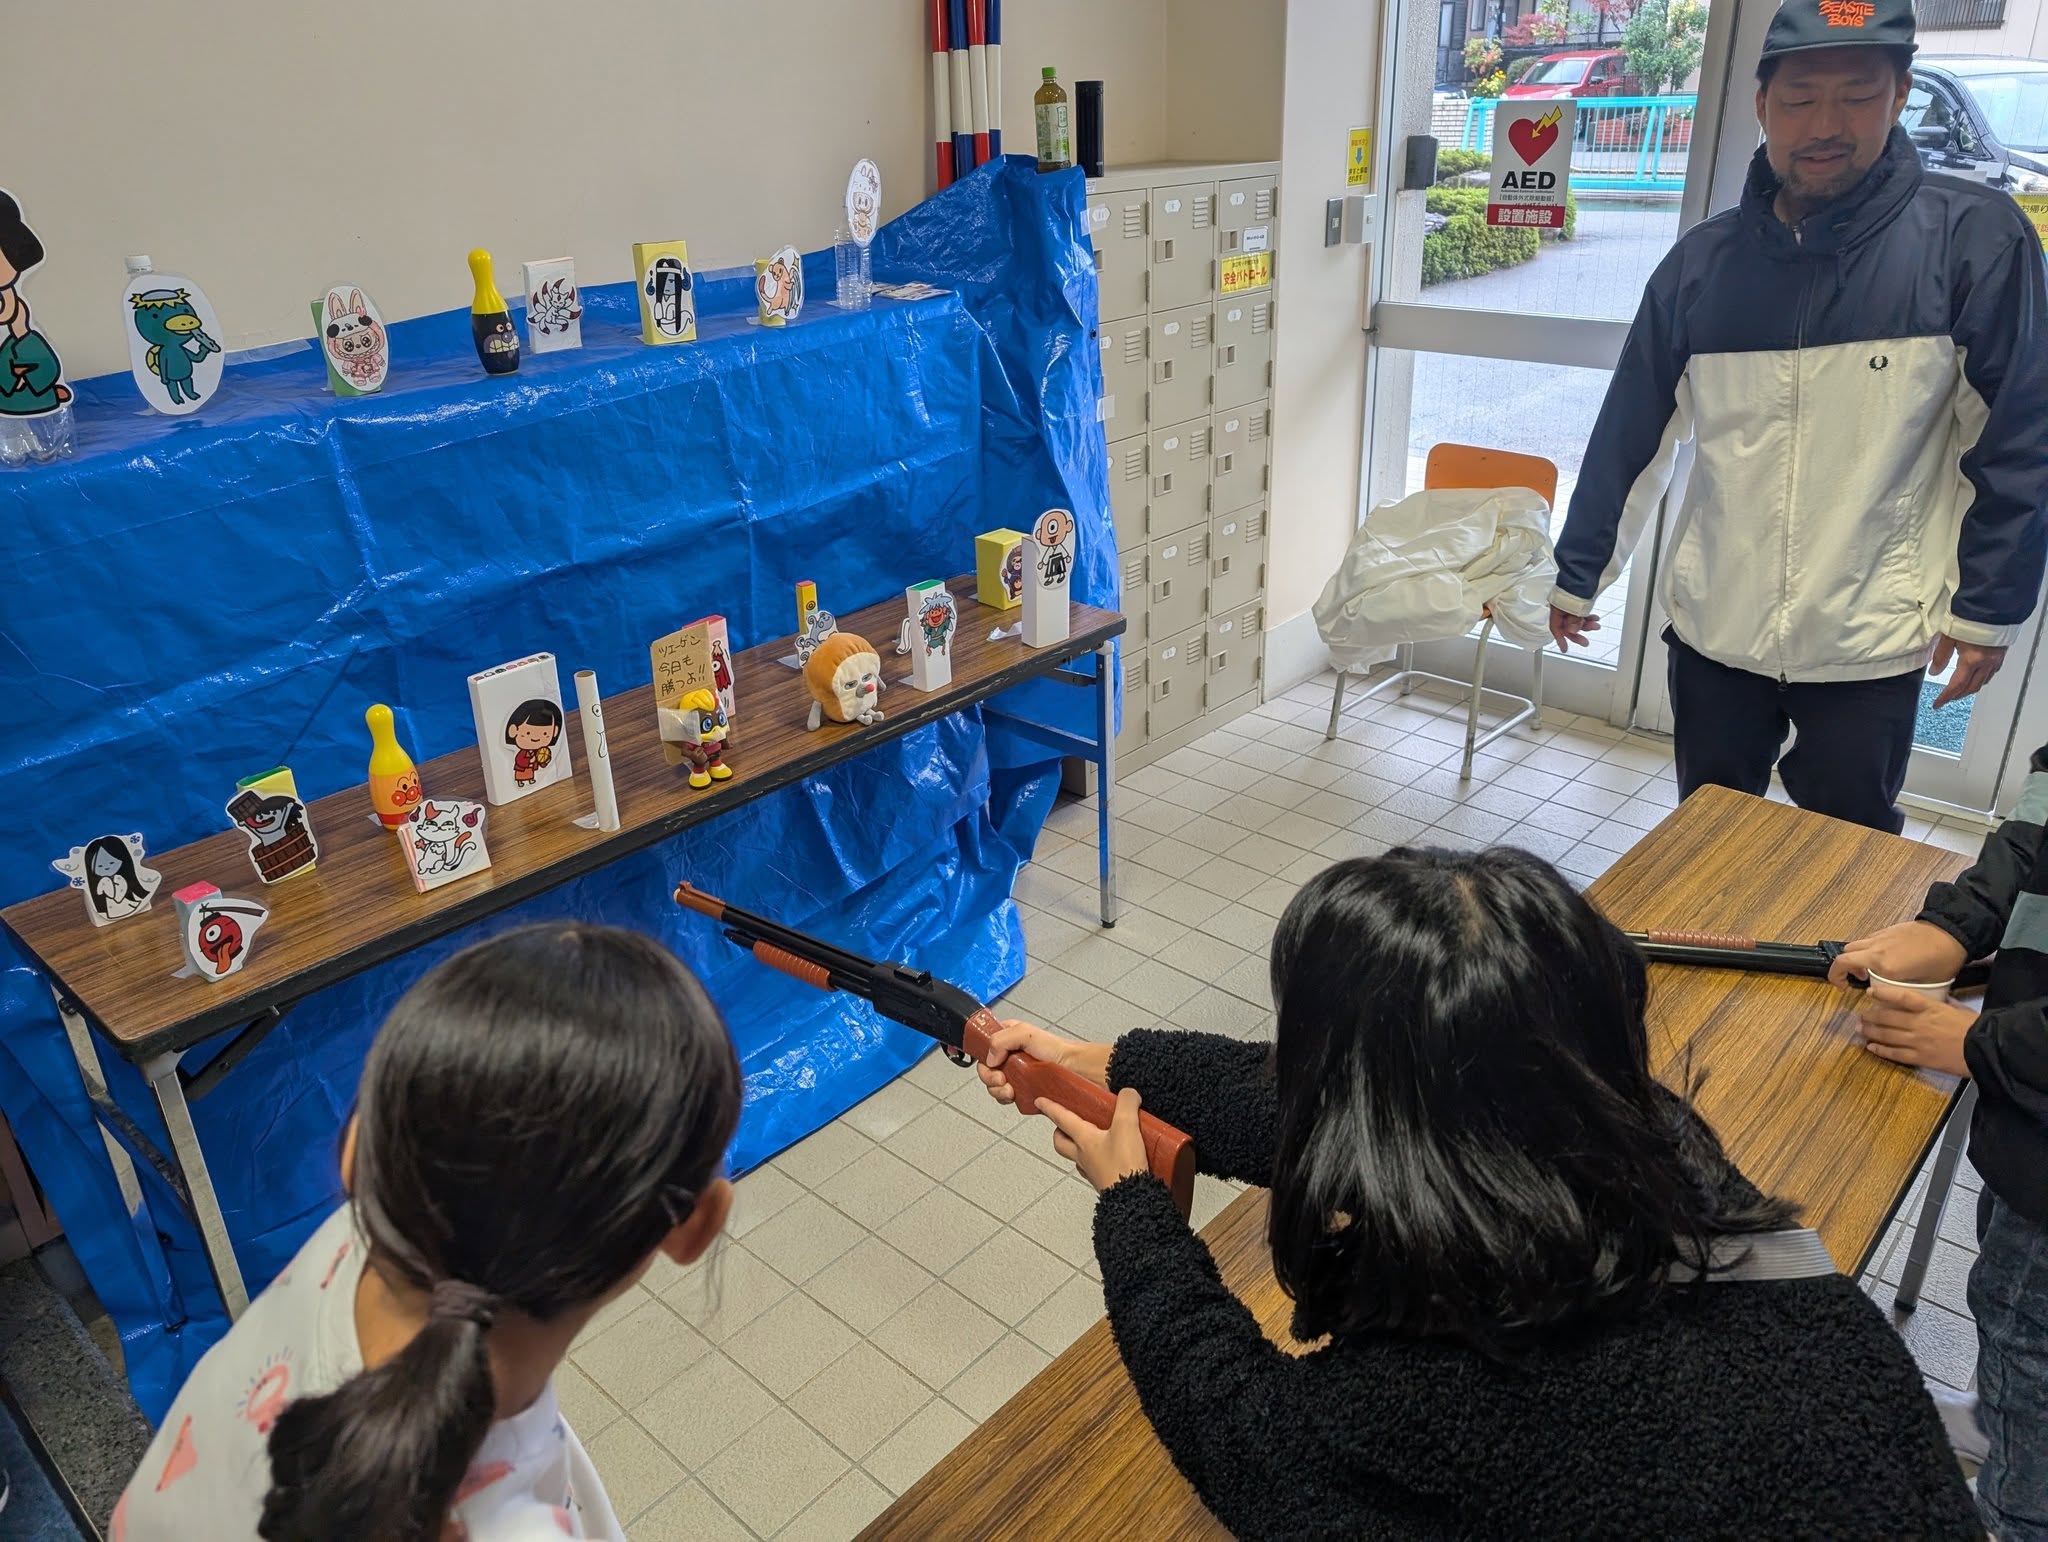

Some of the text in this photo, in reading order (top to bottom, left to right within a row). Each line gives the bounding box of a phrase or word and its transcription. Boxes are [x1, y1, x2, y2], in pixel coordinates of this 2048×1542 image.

[1818, 0, 1876, 16] BEASTIE
[1826, 13, 1865, 27] BOYS
[1501, 170, 1557, 190] AED
[1497, 208, 1553, 225] 設置施設
[659, 655, 694, 677] 今日も
